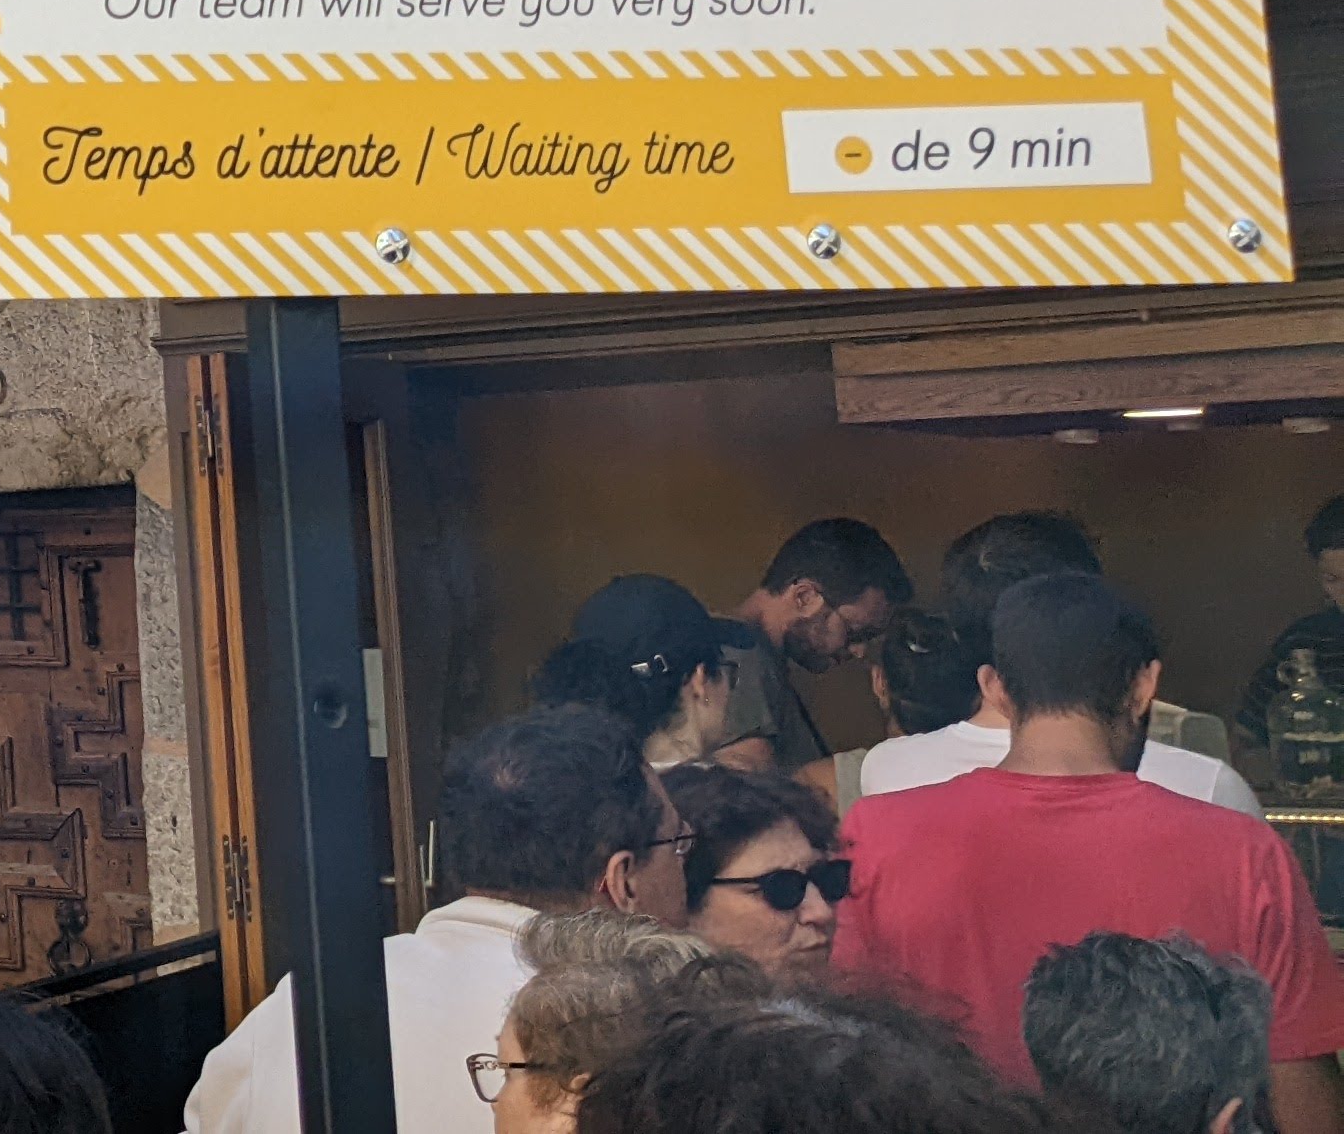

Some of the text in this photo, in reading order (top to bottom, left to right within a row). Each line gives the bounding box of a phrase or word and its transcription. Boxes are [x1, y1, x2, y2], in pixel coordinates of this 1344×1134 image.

[42, 126, 196, 197] Temps
[217, 126, 400, 180] d'attente
[447, 122, 630, 194] Waiting
[643, 130, 735, 176] time
[891, 126, 1093, 172] de 9 min
